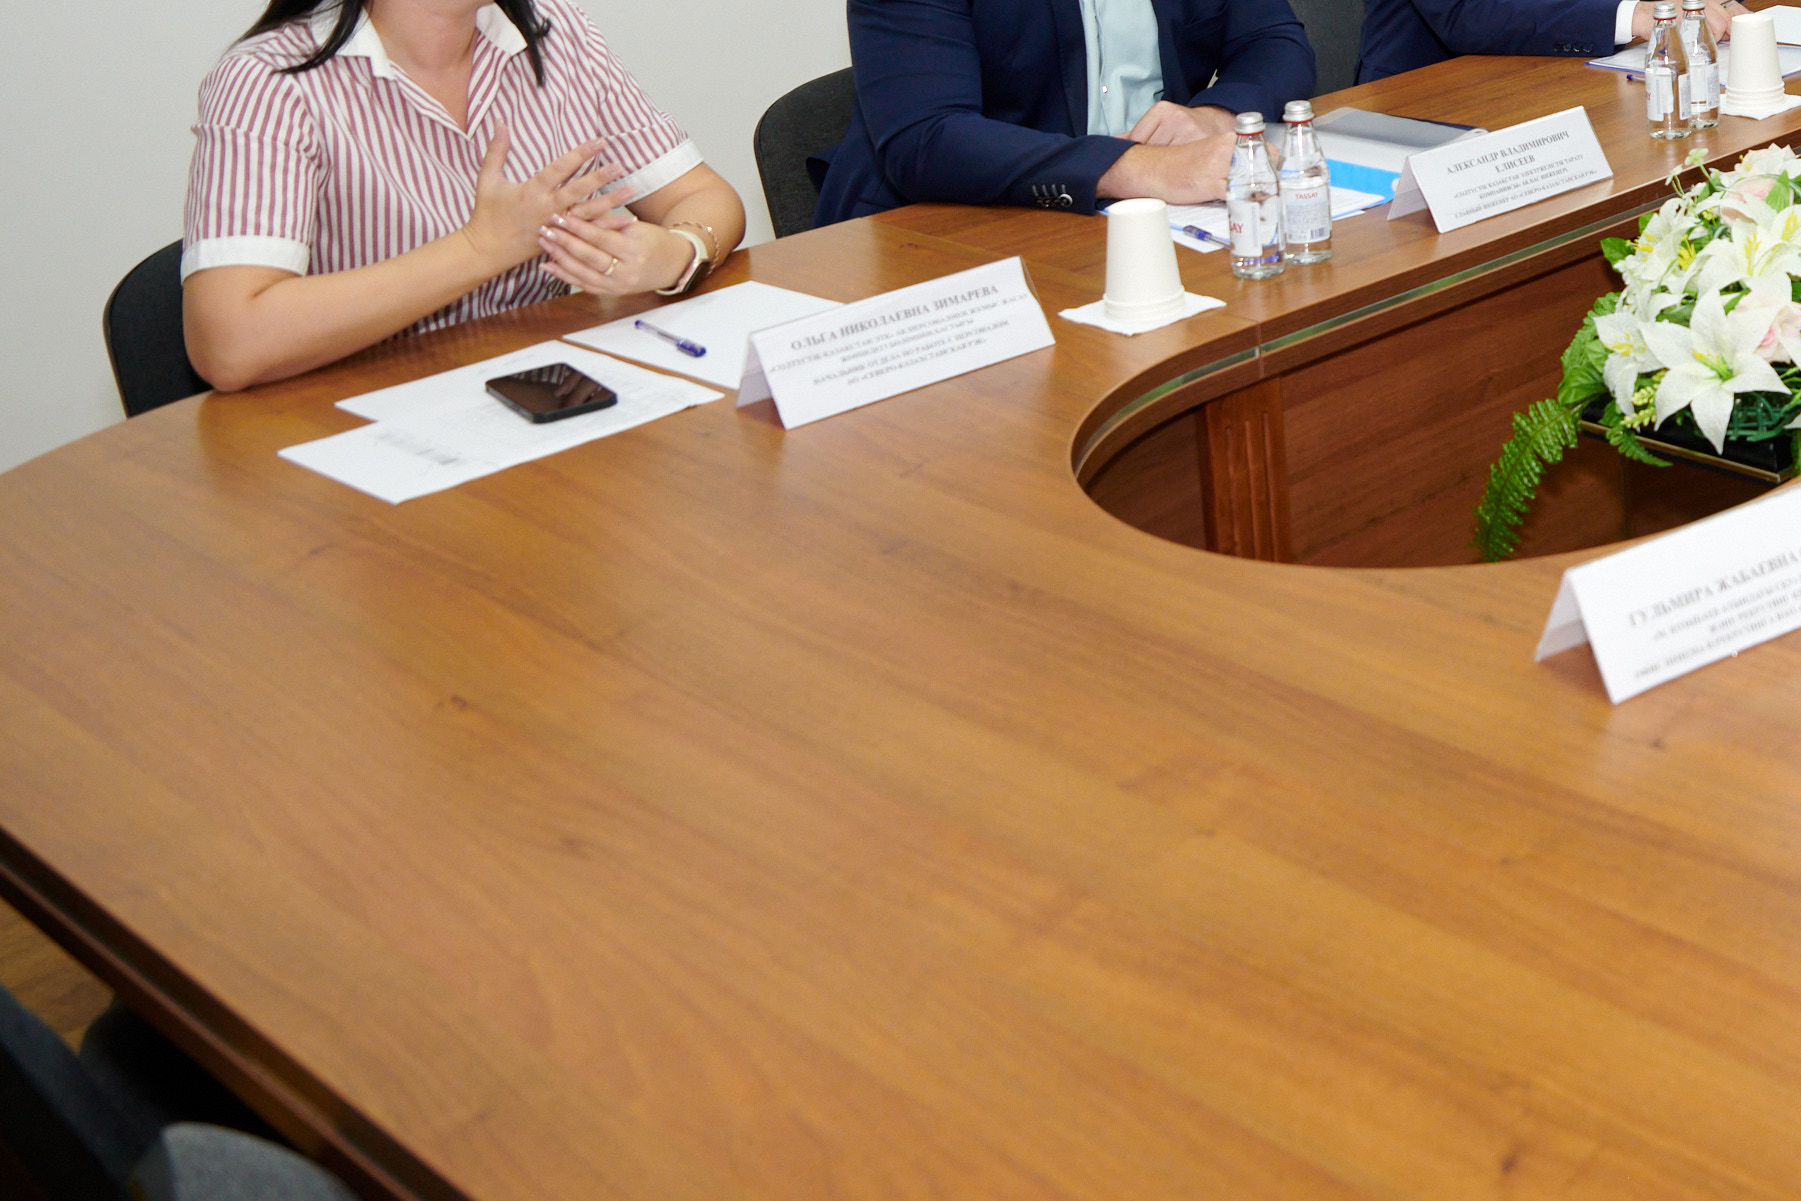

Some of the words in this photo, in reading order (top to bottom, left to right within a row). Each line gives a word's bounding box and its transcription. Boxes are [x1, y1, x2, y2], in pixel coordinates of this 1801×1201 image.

[1446, 151, 1499, 175] АЛЕКСАНДР
[1499, 130, 1570, 158] ВЛАДИМИРОВИЧ
[1494, 154, 1536, 174] ЕЛИСЕЕВ
[790, 330, 838, 351] ОЛЬГА
[839, 304, 930, 337] НИКОЛАЕВНА
[933, 285, 999, 311] ЗИМАРЕВА
[1628, 585, 1714, 627] ГУЛЬМИРА
[1717, 552, 1799, 592] ЖАБАЕВНА
